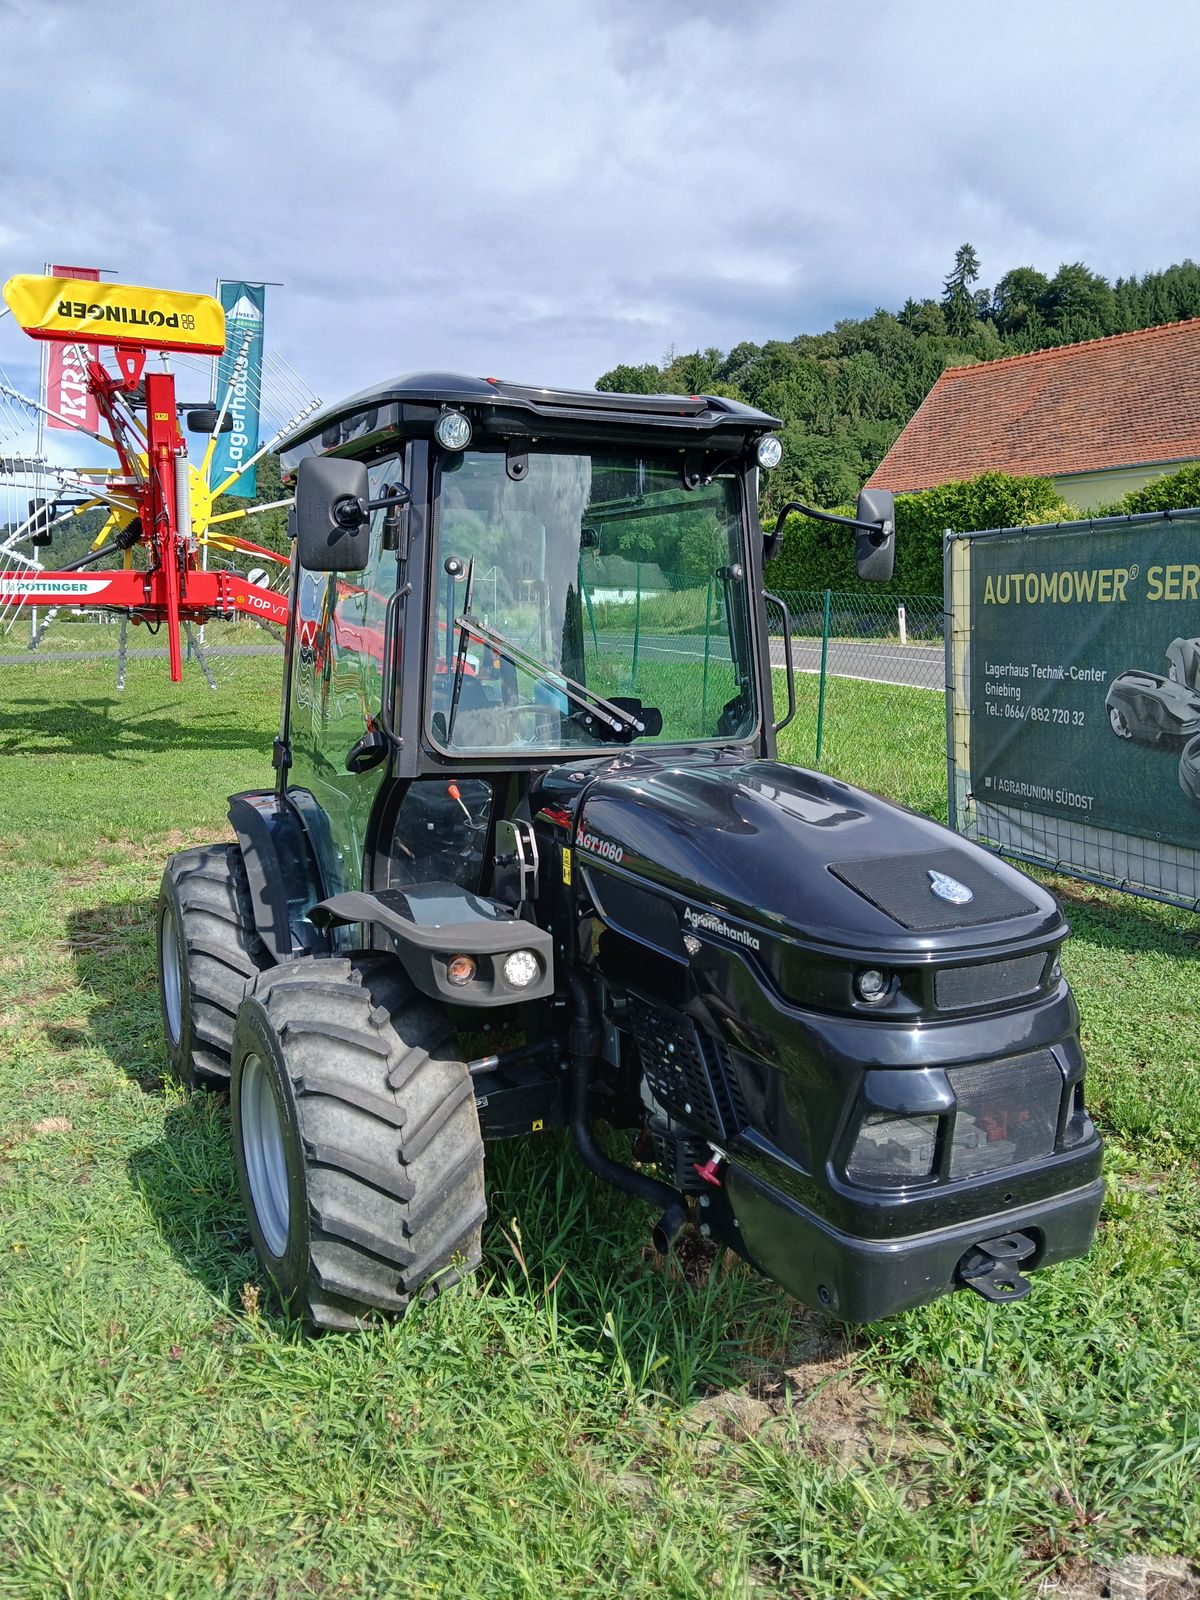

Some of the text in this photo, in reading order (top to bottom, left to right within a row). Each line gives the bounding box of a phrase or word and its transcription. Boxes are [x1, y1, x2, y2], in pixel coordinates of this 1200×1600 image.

[248, 594, 288, 616] TOP VT
[985, 661, 1107, 682] Lagerhaus Technik-Center
[985, 682, 1021, 701] Gniebing
[985, 702, 1085, 726] Tel.: 0664/882 720 32
[998, 778, 1094, 810] AGRARUNION SÜDOST
[684, 906, 760, 951] Agromehanika
